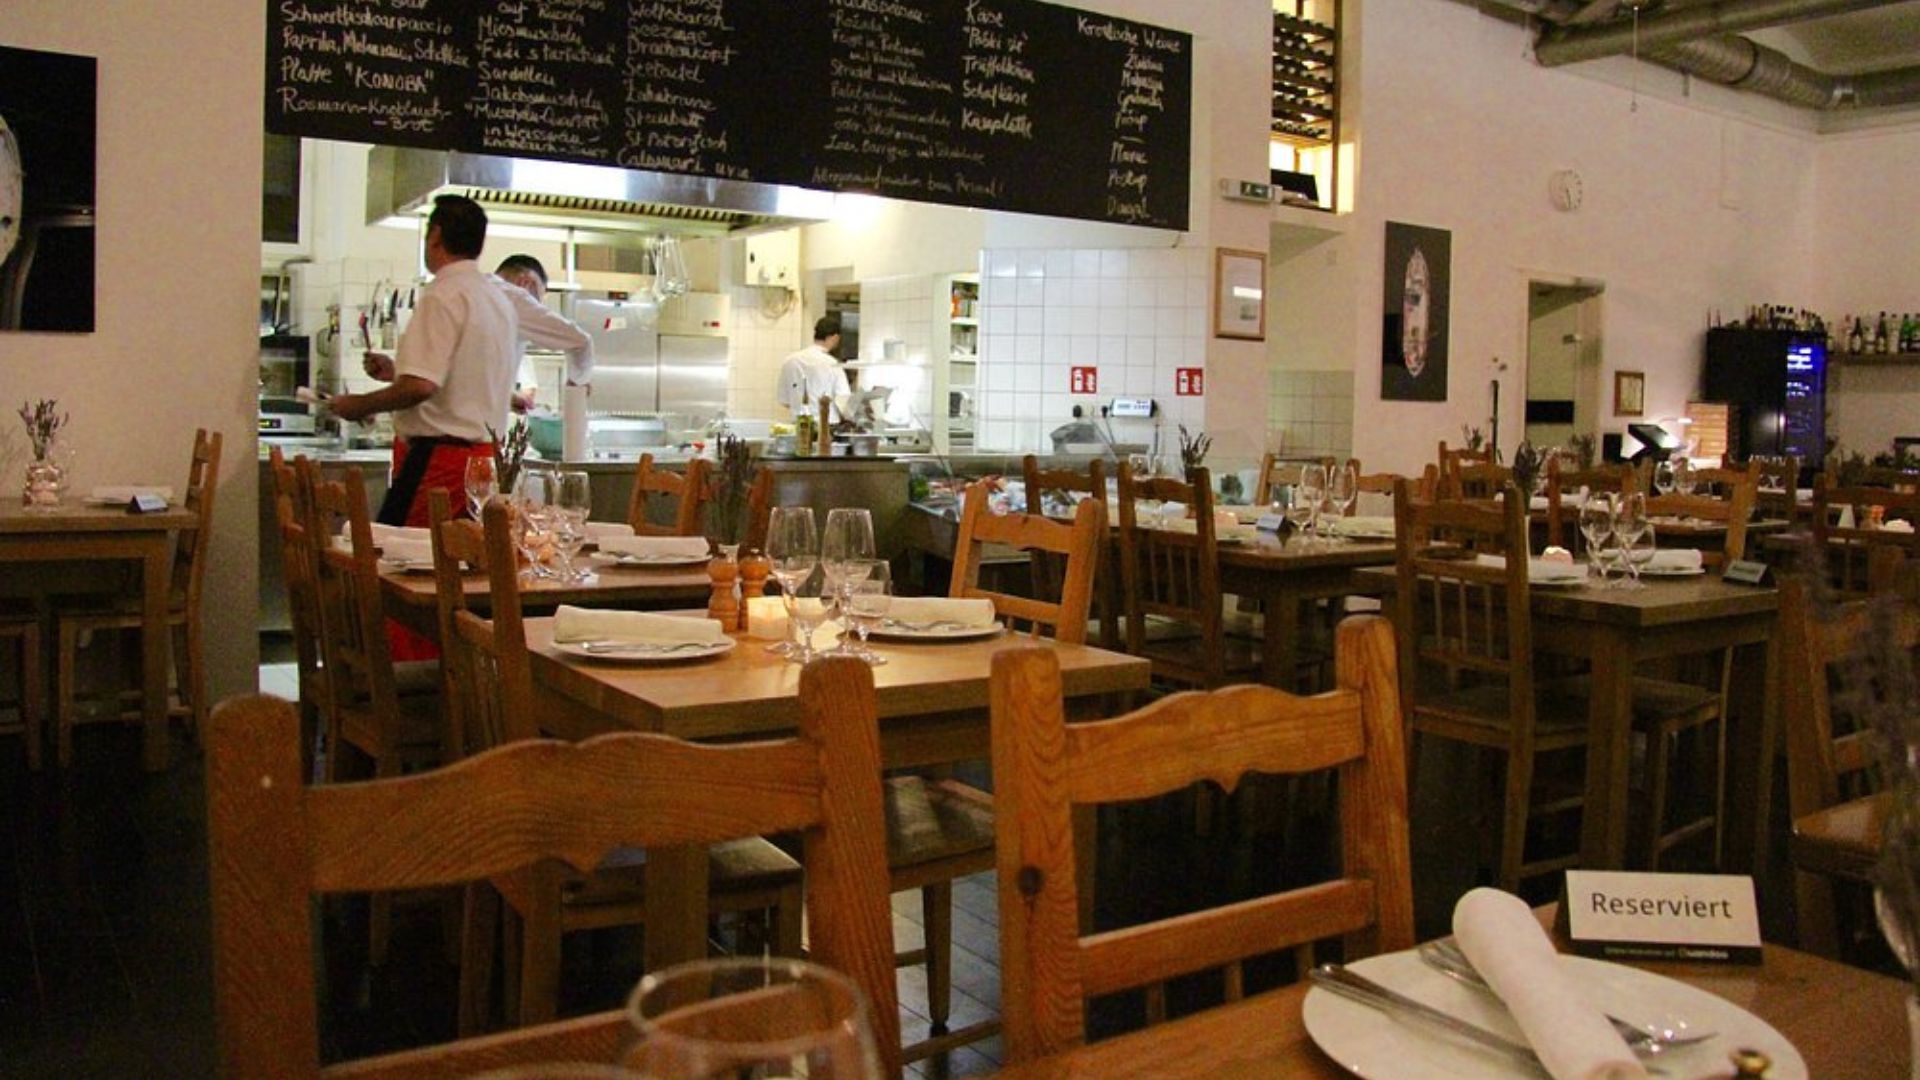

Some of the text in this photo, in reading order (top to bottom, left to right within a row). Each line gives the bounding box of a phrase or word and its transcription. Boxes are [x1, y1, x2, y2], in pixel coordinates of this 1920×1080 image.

[965, 0, 1004, 28] Käse
[281, 55, 435, 93] Platte "KONOBA"
[478, 61, 556, 87] Sardellen
[1591, 892, 1733, 919] Reserviert
